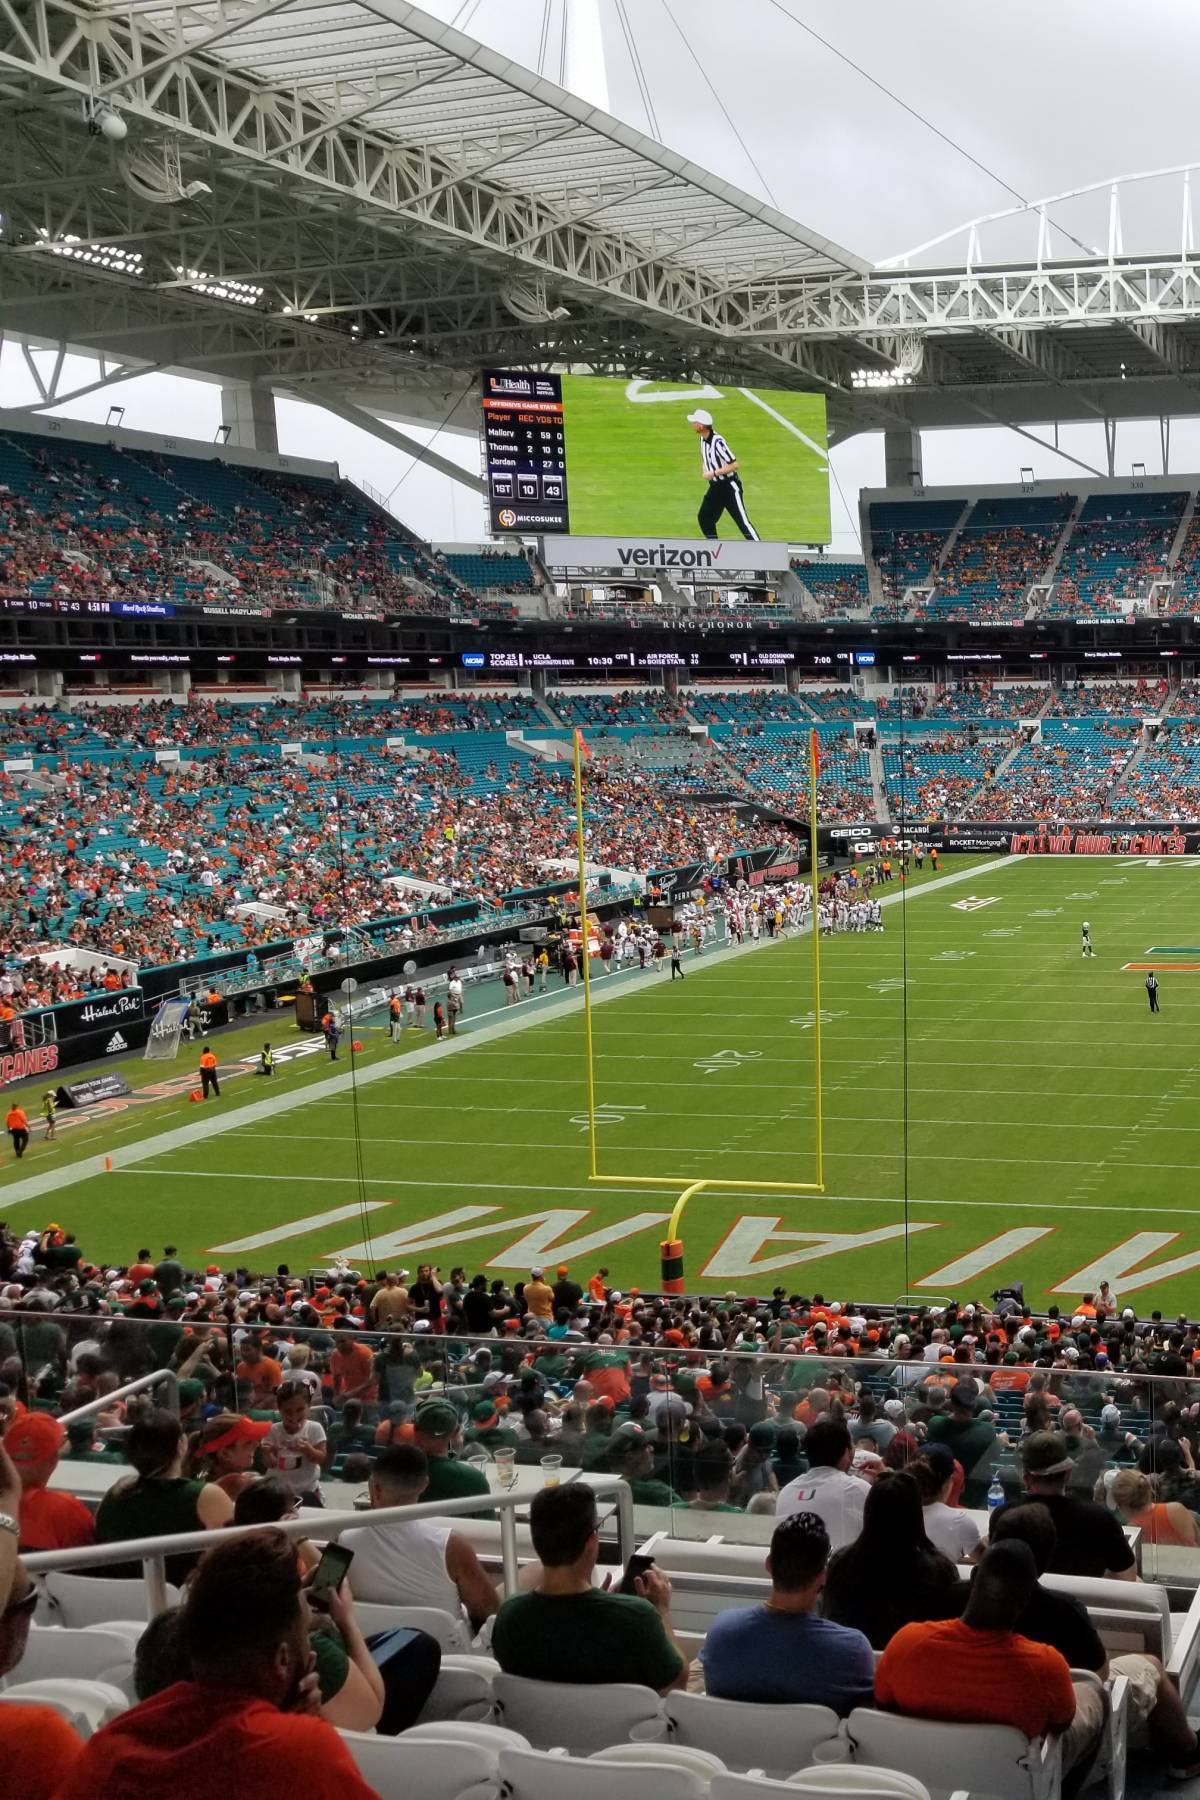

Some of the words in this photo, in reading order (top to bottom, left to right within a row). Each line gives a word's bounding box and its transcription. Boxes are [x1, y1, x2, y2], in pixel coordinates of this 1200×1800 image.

[488, 428, 515, 438] Mallory
[526, 431, 532, 439] 2
[489, 443, 518, 452] Thomas
[490, 458, 516, 466] Jordan
[495, 485, 511, 493] 1ST
[523, 486, 534, 495] 10
[546, 487, 560, 496] 43
[617, 544, 713, 566] verizon
[28, 601, 37, 610] 10
[70, 603, 80, 611] 43
[588, 657, 613, 665] 10:30
[814, 656, 831, 664] 7:00
[831, 827, 871, 838] GEICO
[106, 1042, 128, 1053] adidas
[797, 1488, 816, 1501] U
